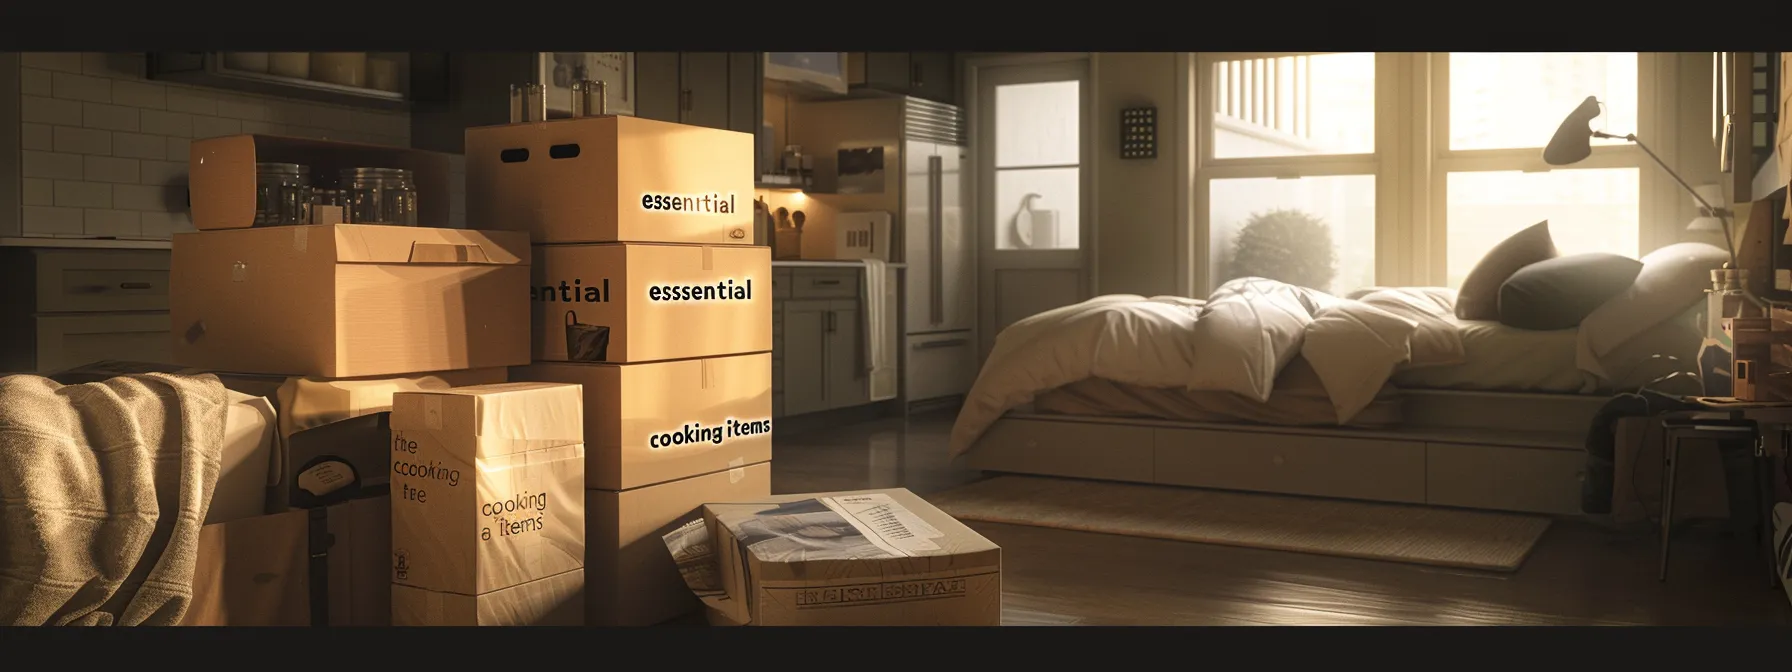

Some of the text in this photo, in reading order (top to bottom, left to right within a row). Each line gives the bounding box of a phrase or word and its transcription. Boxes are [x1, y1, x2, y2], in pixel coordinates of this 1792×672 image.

[649, 279, 752, 301] esssential
[394, 431, 418, 454] the
[650, 419, 770, 449] cooking items
[482, 490, 546, 517] cooking
[481, 527, 491, 541] a
